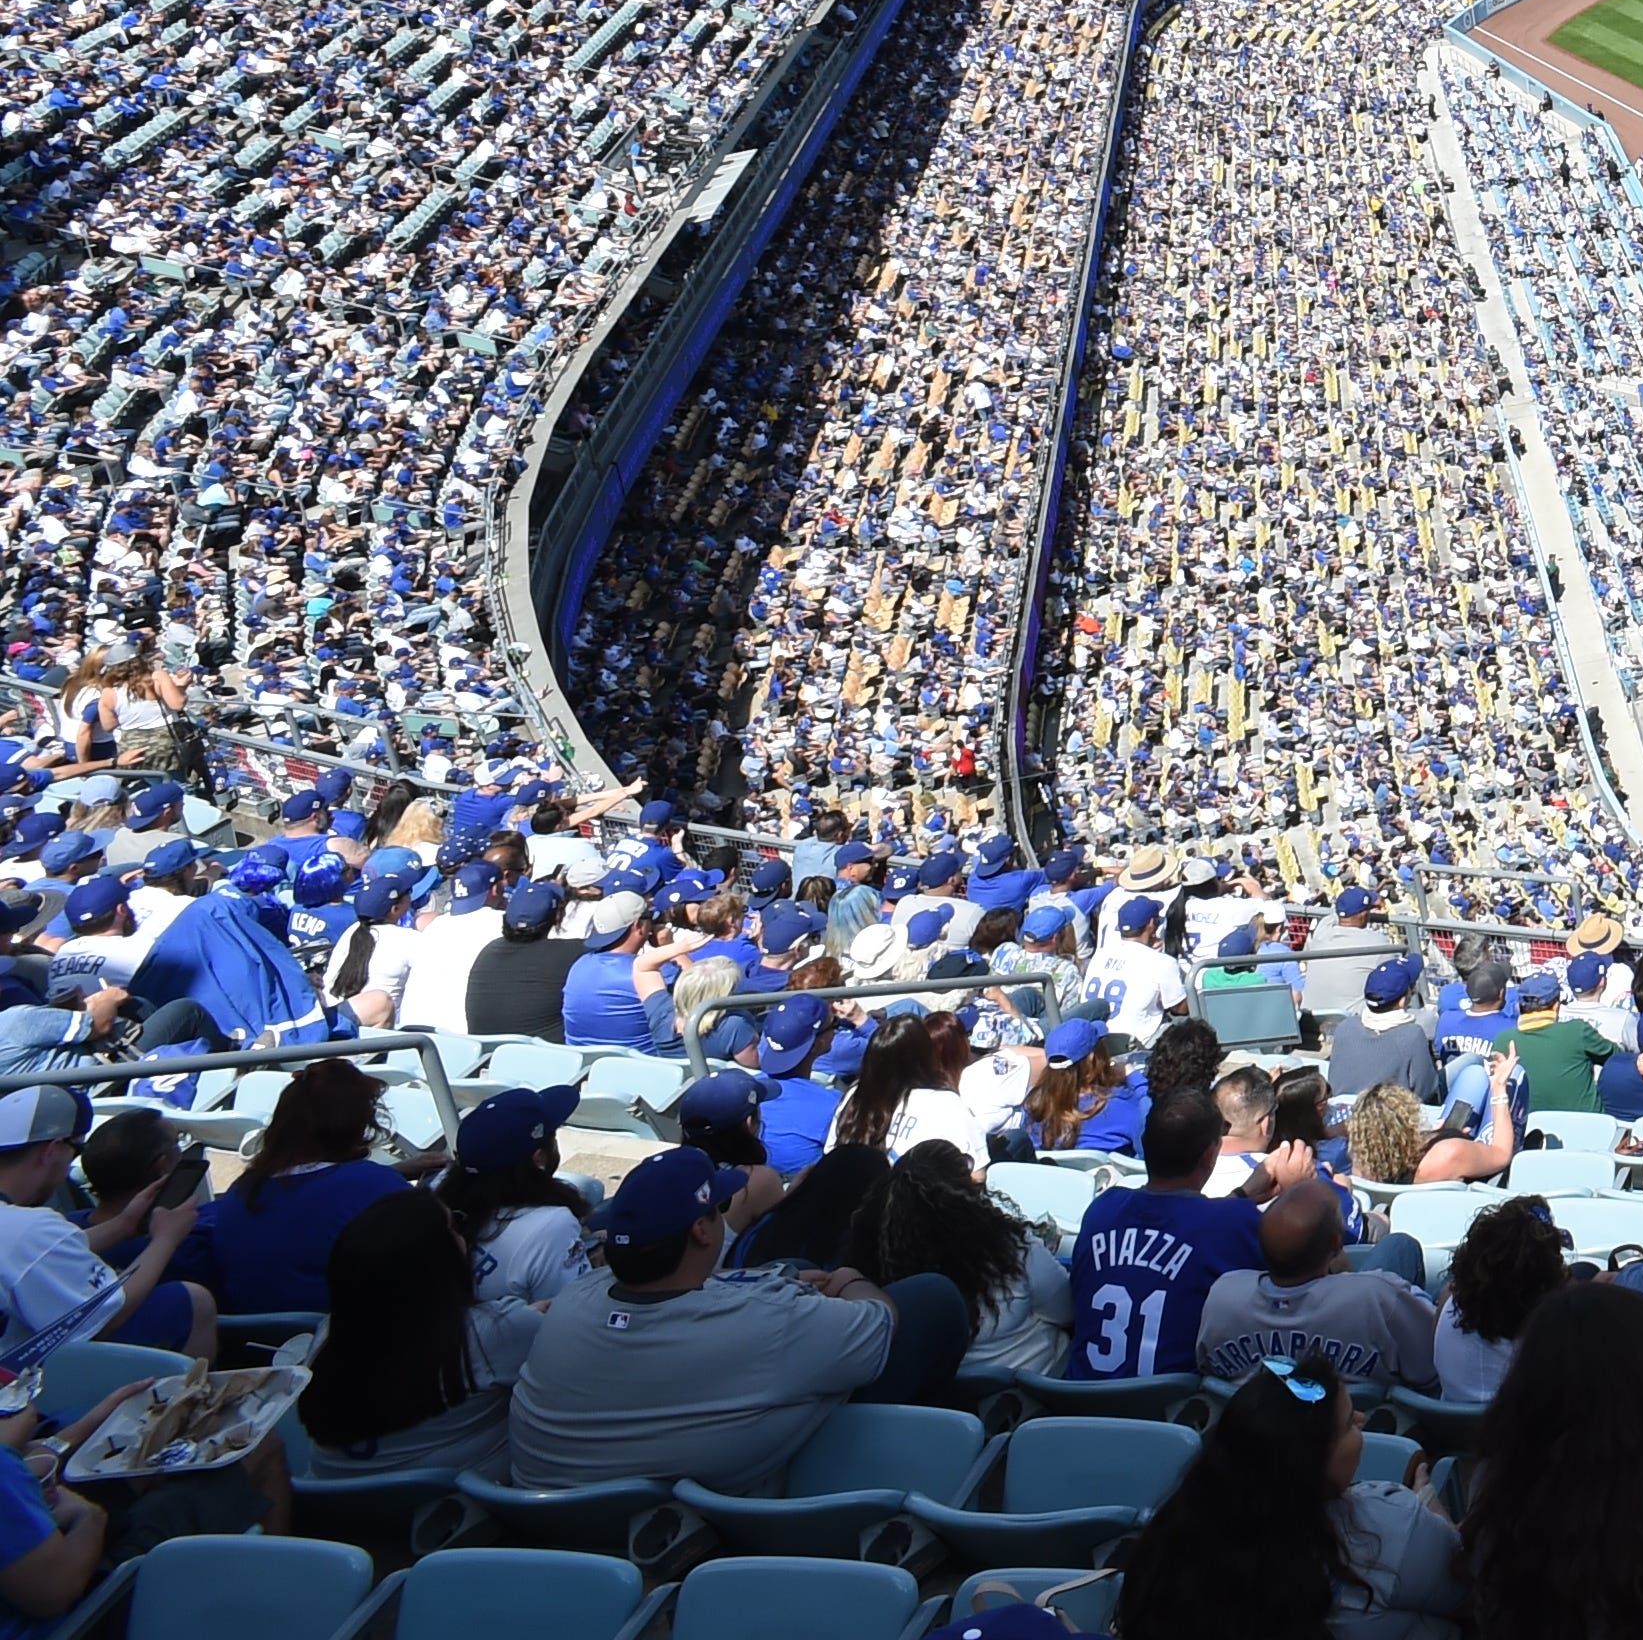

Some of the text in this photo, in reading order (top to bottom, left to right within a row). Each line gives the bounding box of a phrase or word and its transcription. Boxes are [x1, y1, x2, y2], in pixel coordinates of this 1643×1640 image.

[455, 878, 469, 898] LA
[291, 911, 327, 937] KEMP
[50, 955, 106, 979] SEAGER
[1085, 977, 1127, 1020] 99
[1091, 1227, 1194, 1281] PIAZZA
[1086, 1283, 1168, 1377] 31
